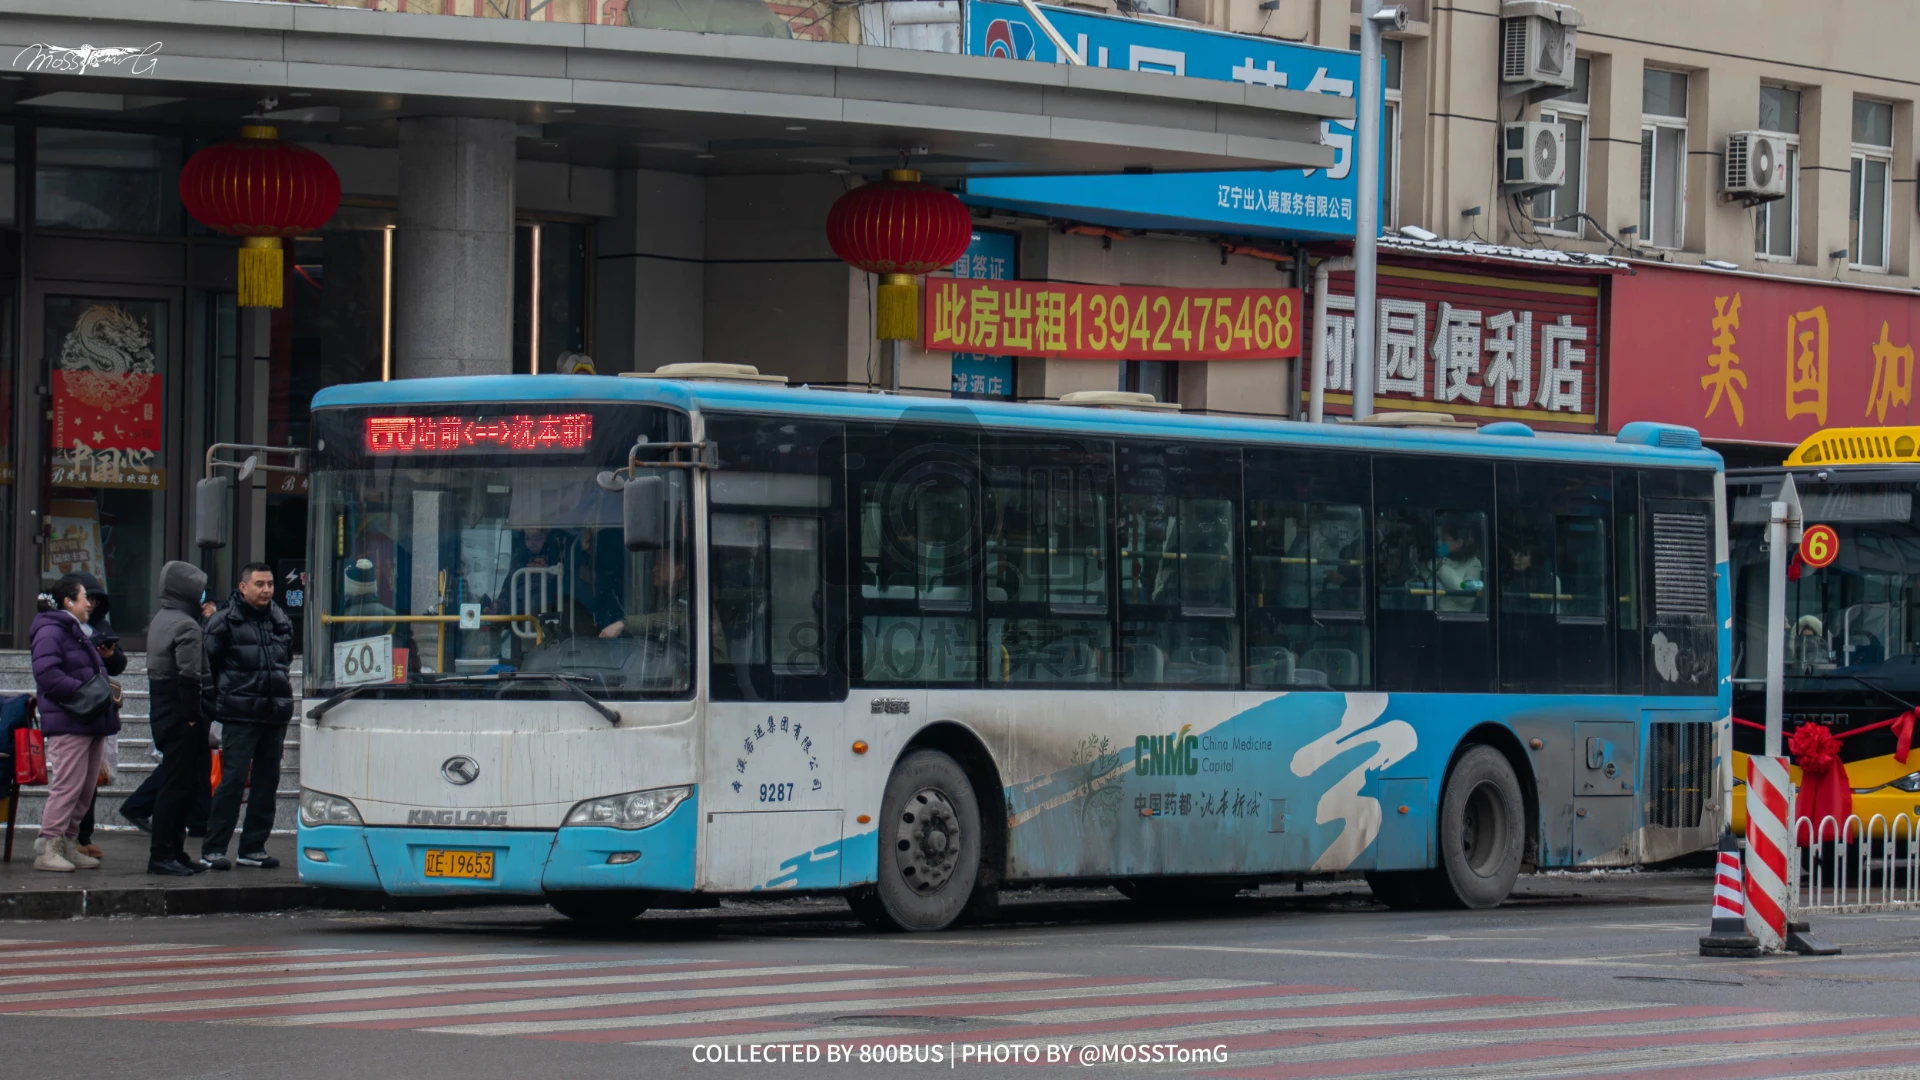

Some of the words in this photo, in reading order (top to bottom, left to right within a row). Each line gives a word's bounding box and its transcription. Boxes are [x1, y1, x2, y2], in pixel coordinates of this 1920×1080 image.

[1217, 185, 1352, 220] 辽宁出入境服务有限公司
[933, 283, 1293, 351] 此房出租13942475468
[64, 438, 154, 483] 中国心
[1809, 531, 1829, 560] 6
[1135, 735, 1199, 776] CNMC
[1202, 736, 1228, 751] China
[1232, 736, 1272, 751] Medicine
[1202, 757, 1234, 774] Capital
[759, 783, 794, 802] 9287
